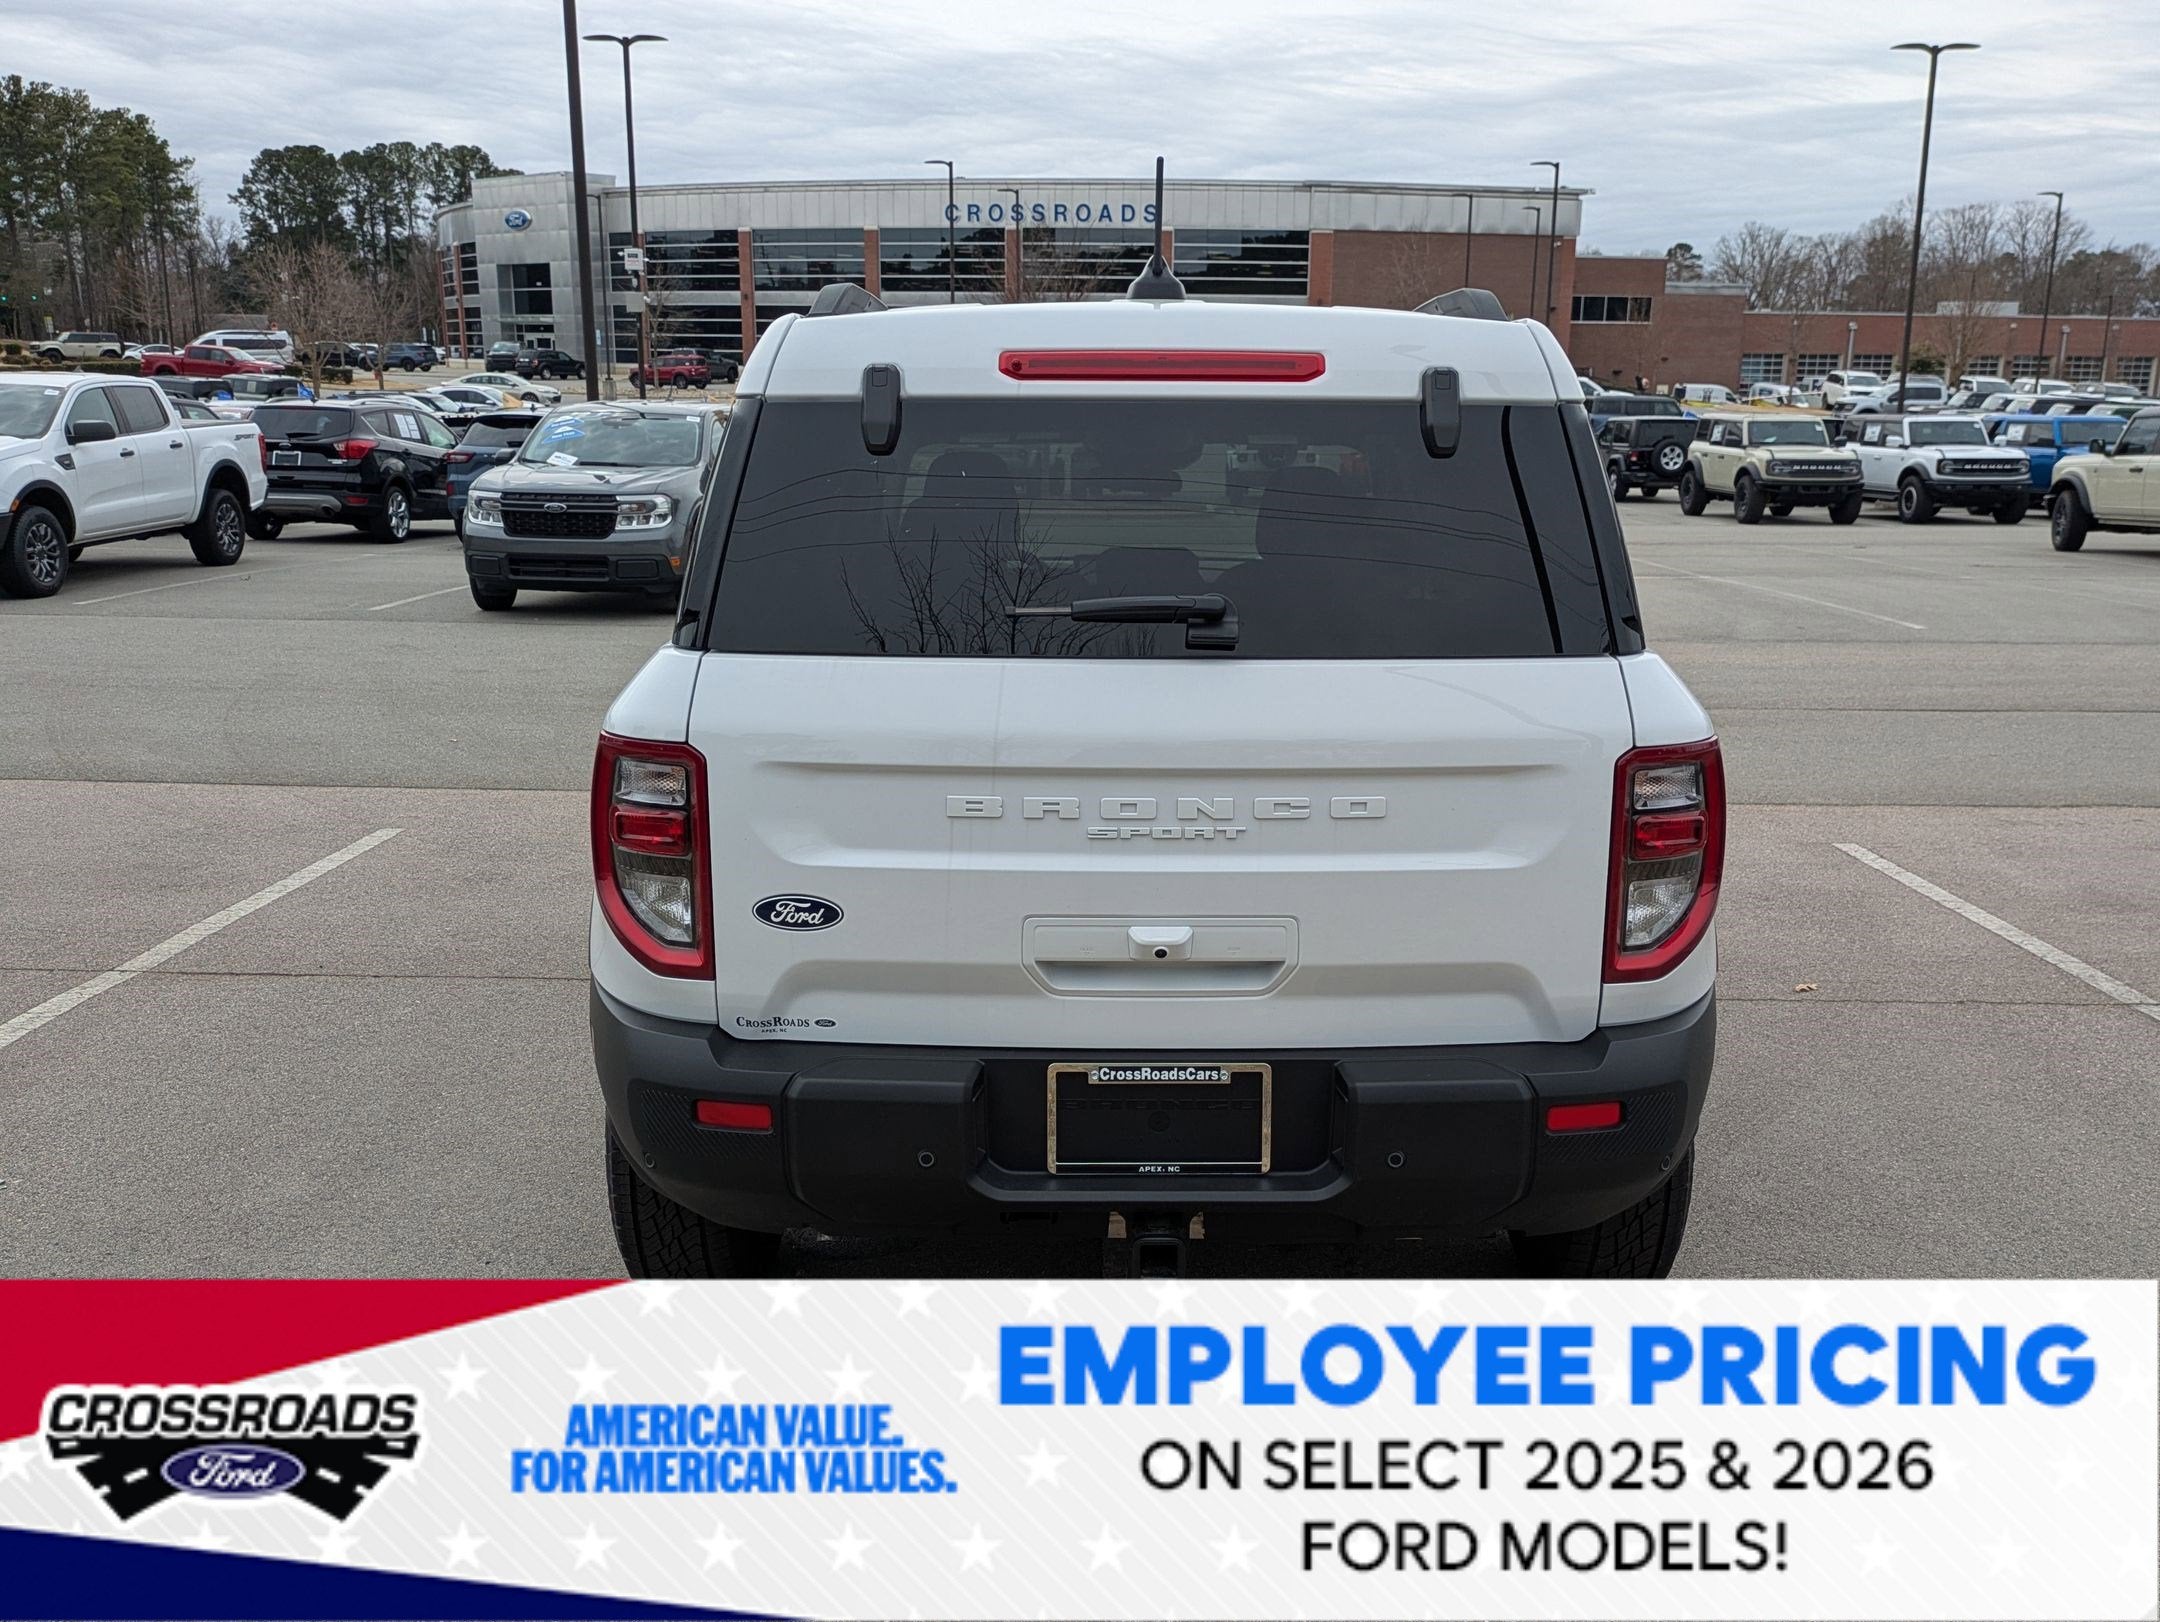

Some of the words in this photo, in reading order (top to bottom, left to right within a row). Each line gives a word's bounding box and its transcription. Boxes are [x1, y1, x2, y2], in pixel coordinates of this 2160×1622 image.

[944, 203, 1158, 223] CROSSROADS
[946, 795, 1387, 820] BRONCO
[1086, 826, 1247, 841] SPORT
[770, 900, 825, 925] Ford
[1099, 1067, 1220, 1081] CrossRoadsCars
